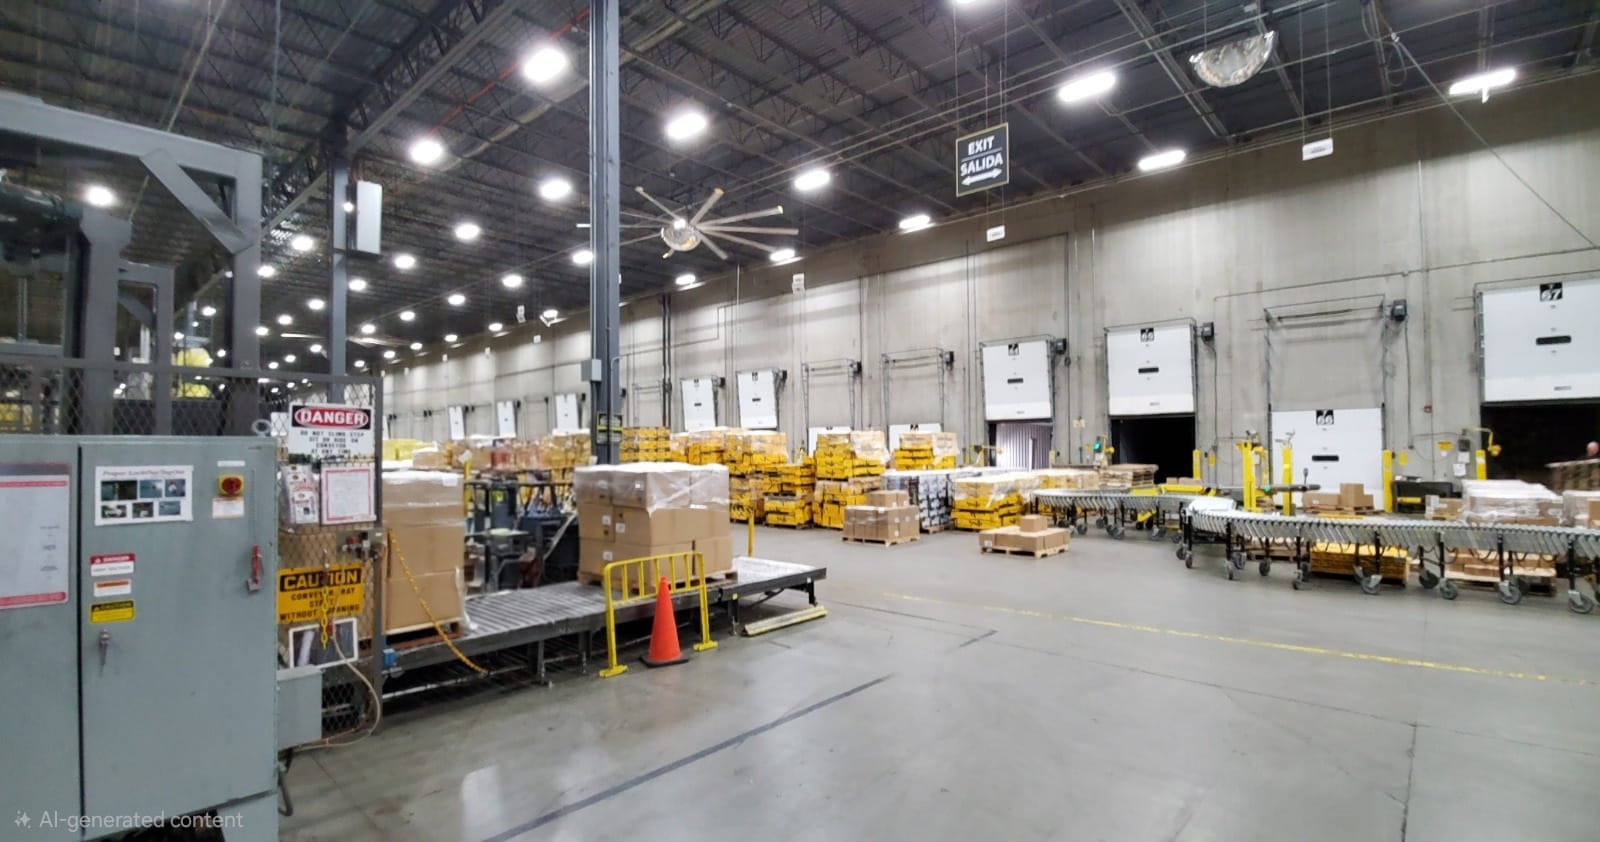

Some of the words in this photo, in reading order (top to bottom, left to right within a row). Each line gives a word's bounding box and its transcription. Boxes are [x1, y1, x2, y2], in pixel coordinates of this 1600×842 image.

[967, 135, 995, 156] EXIT
[960, 152, 1004, 177] SALIDA
[300, 408, 364, 425] DANGER
[283, 570, 358, 590] CAUION
[309, 598, 334, 608] STAT
